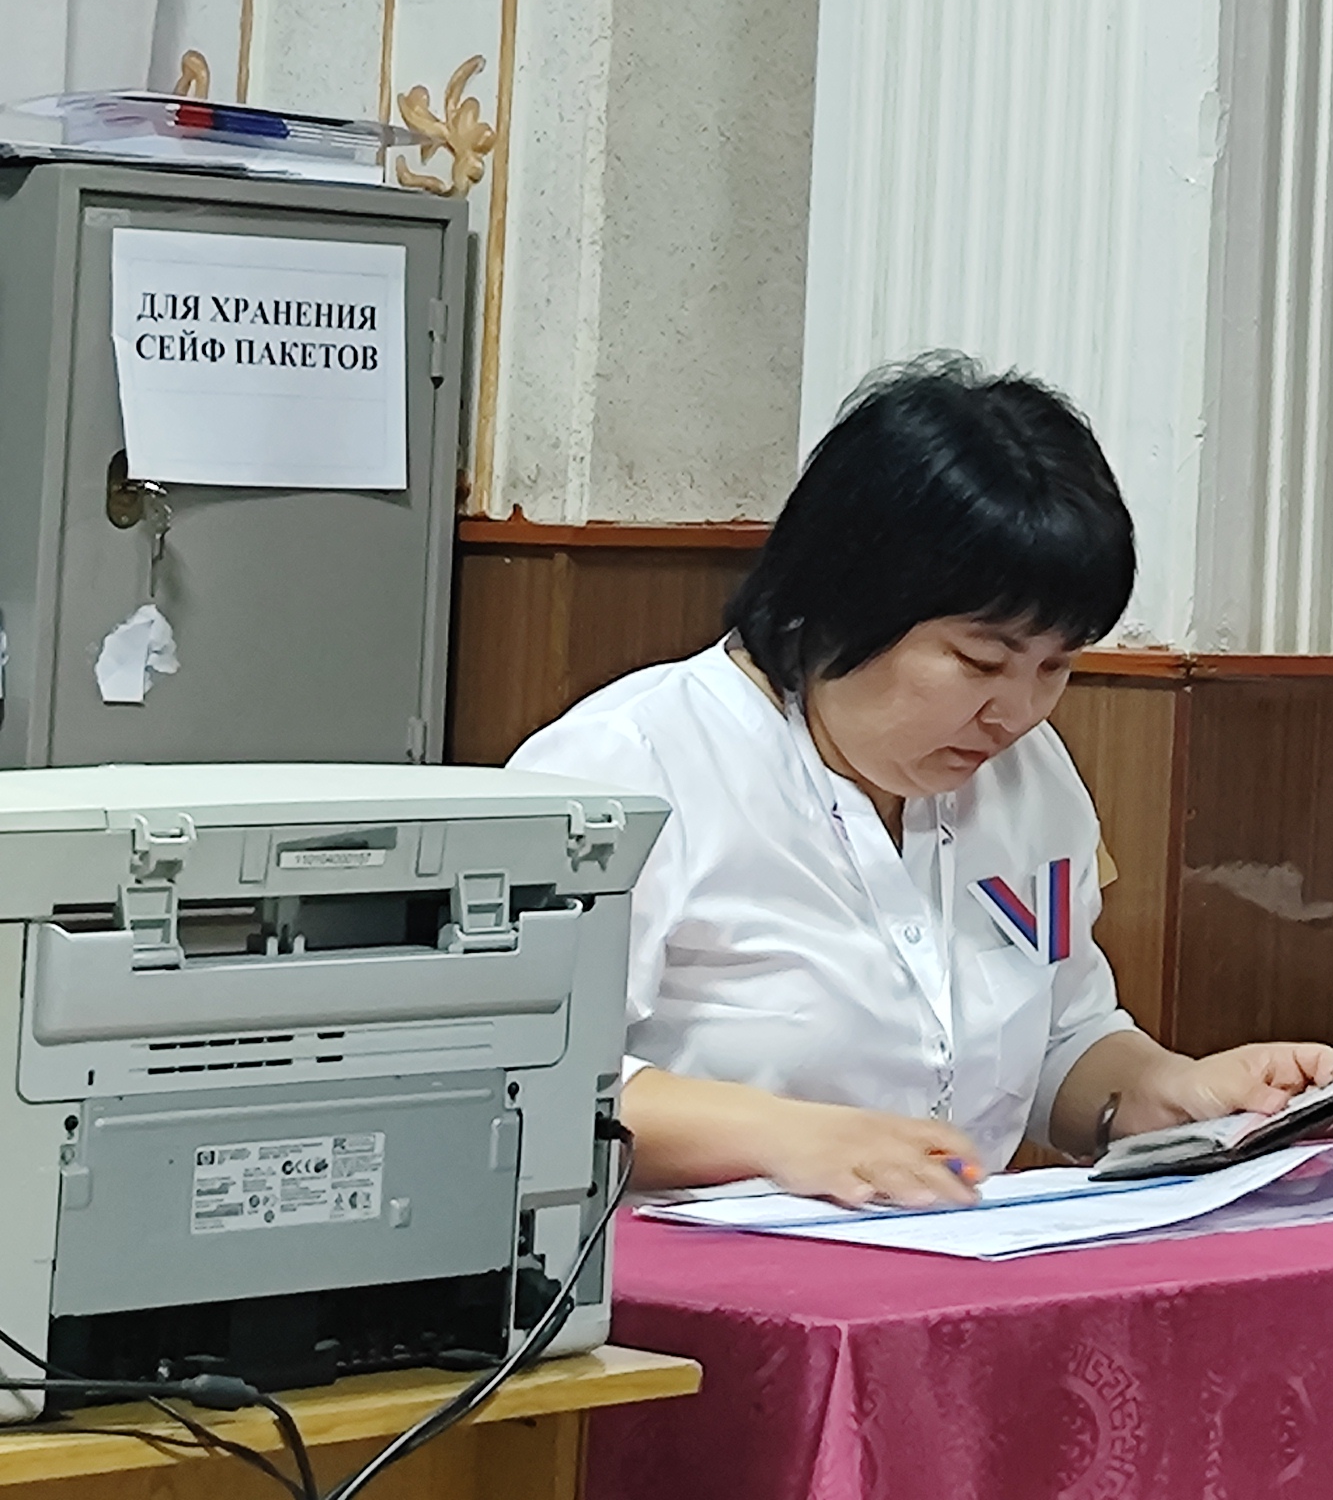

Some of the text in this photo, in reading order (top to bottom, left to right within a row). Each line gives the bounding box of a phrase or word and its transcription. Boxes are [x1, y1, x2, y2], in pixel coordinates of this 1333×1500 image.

[136, 291, 377, 331] ДЛЯ ХРАНЕНИЯ
[135, 328, 379, 371] СЕЙФ ПАКЕТОВ
